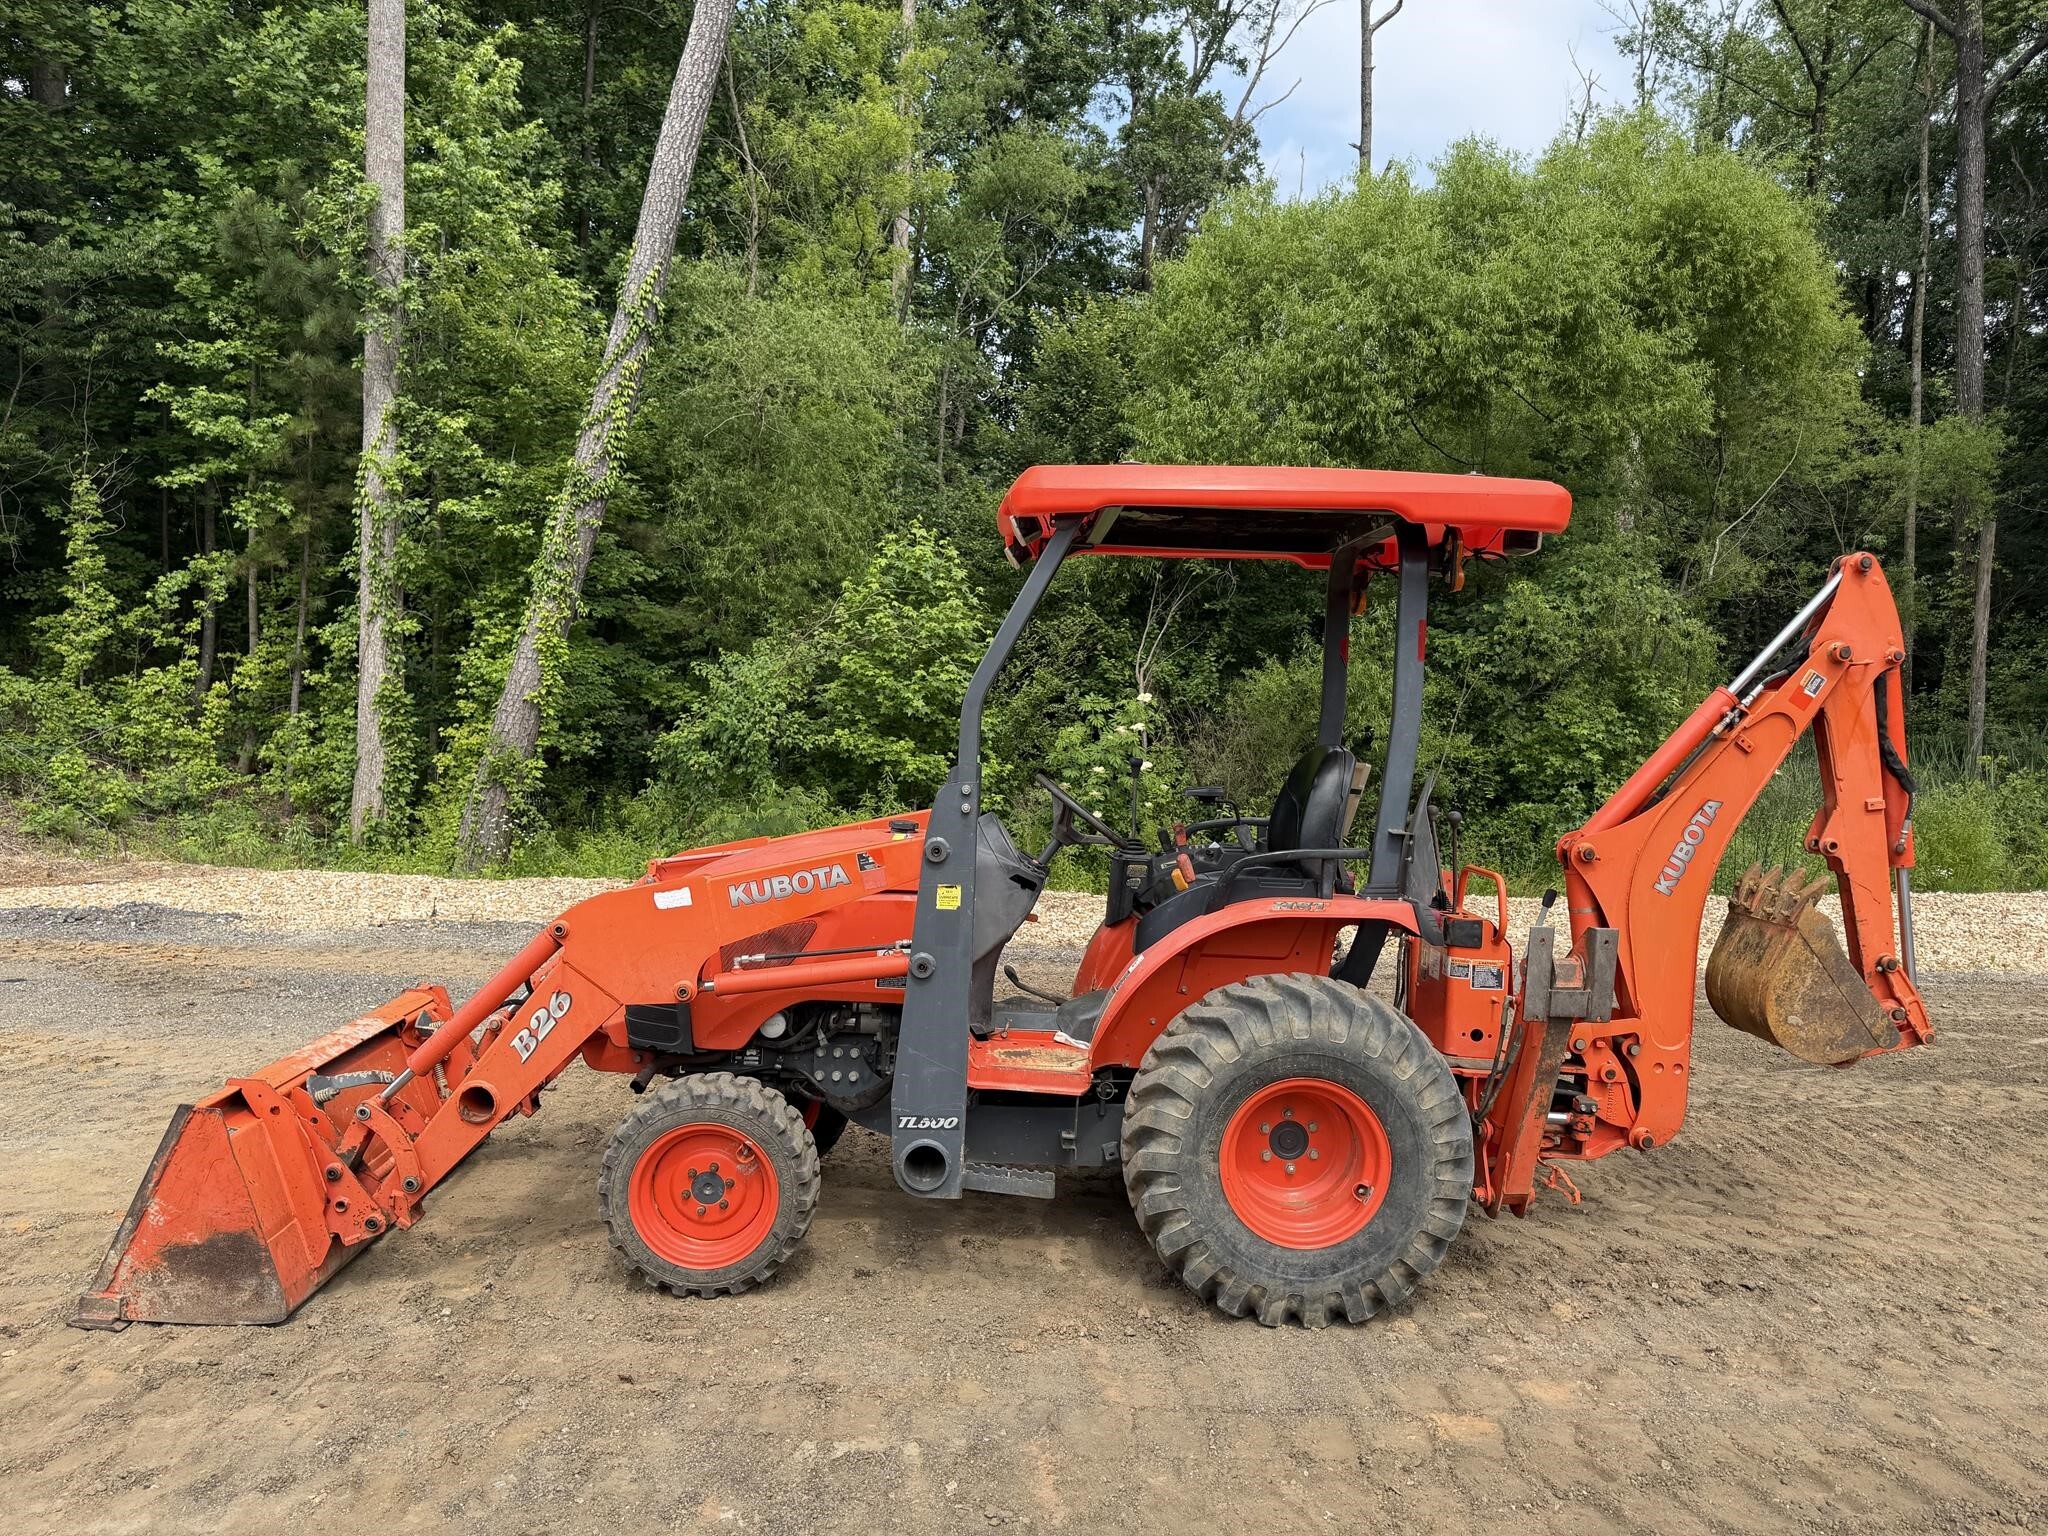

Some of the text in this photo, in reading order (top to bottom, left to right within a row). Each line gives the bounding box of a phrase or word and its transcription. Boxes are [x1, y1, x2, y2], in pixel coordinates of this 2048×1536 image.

[1653, 799, 1724, 897] KUBOTA
[728, 864, 852, 908] KUBOTA
[509, 990, 573, 1064] B26
[898, 1116, 959, 1130] TL500
